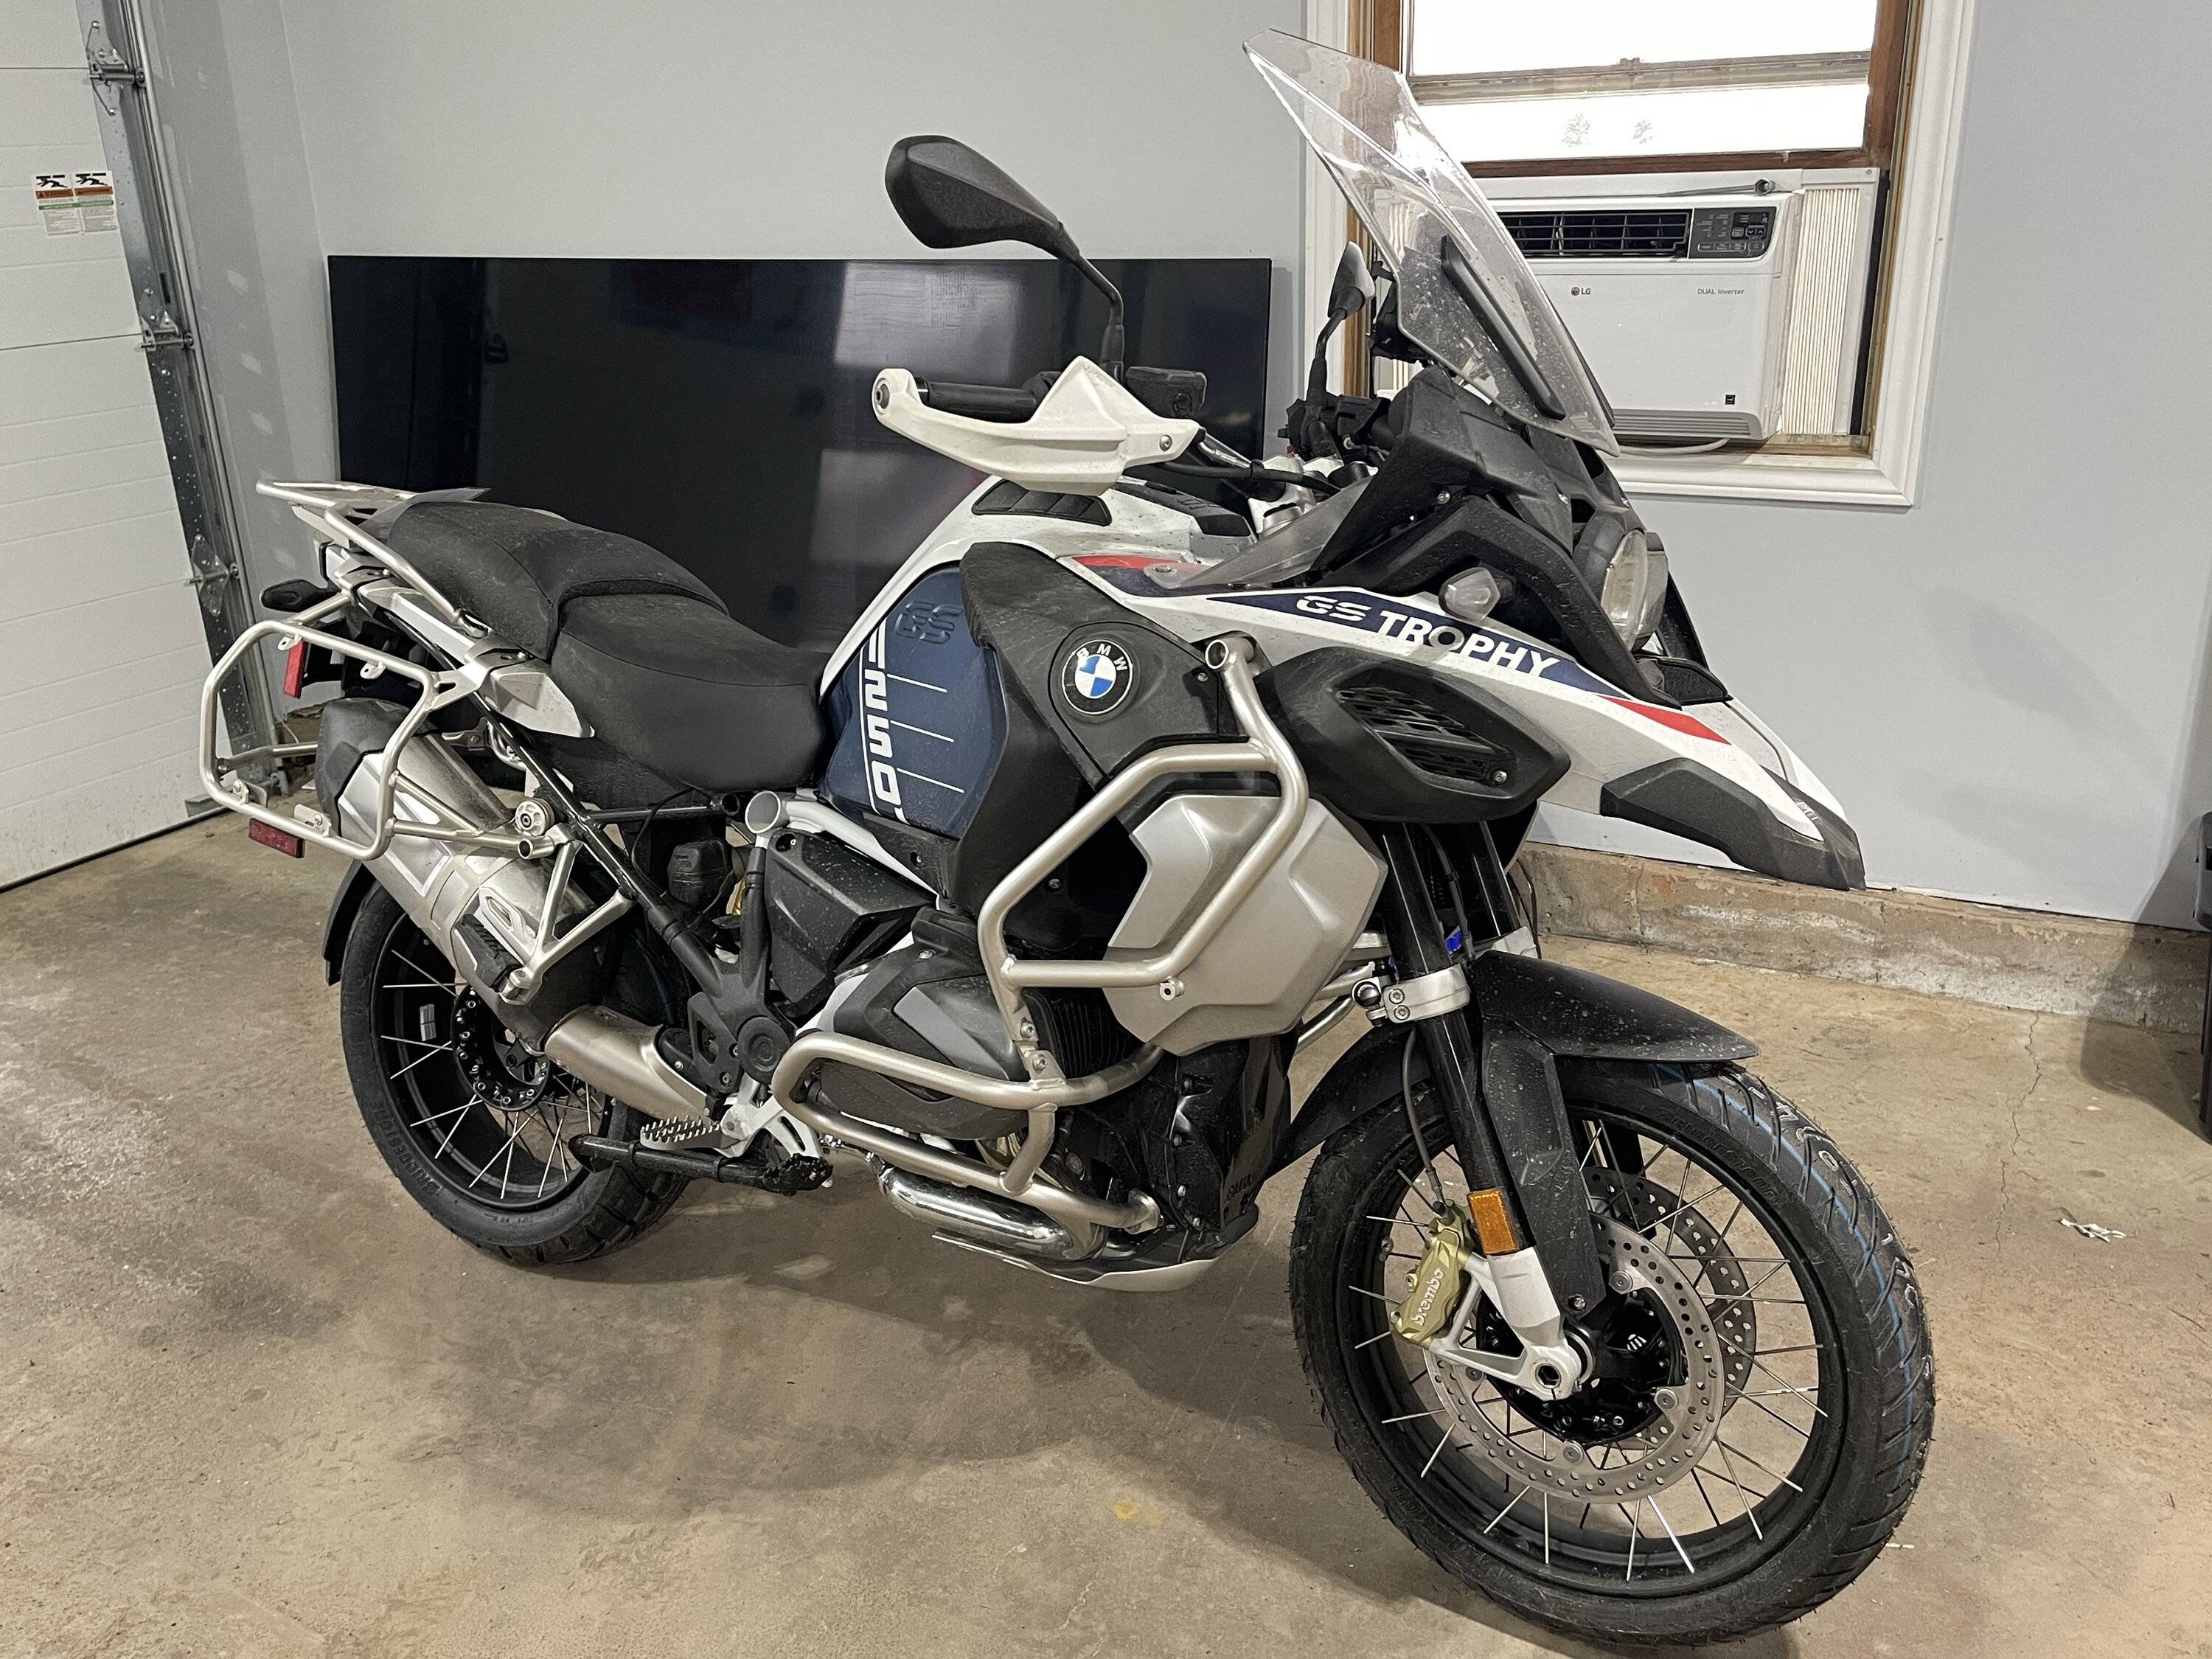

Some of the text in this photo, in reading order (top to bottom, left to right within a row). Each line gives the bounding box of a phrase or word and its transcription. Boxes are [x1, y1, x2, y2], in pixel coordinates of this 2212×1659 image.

[1076, 642, 1128, 671] BMW
[1295, 595, 1560, 676] GS TROPHY
[1411, 1267, 1444, 1326] brembo
